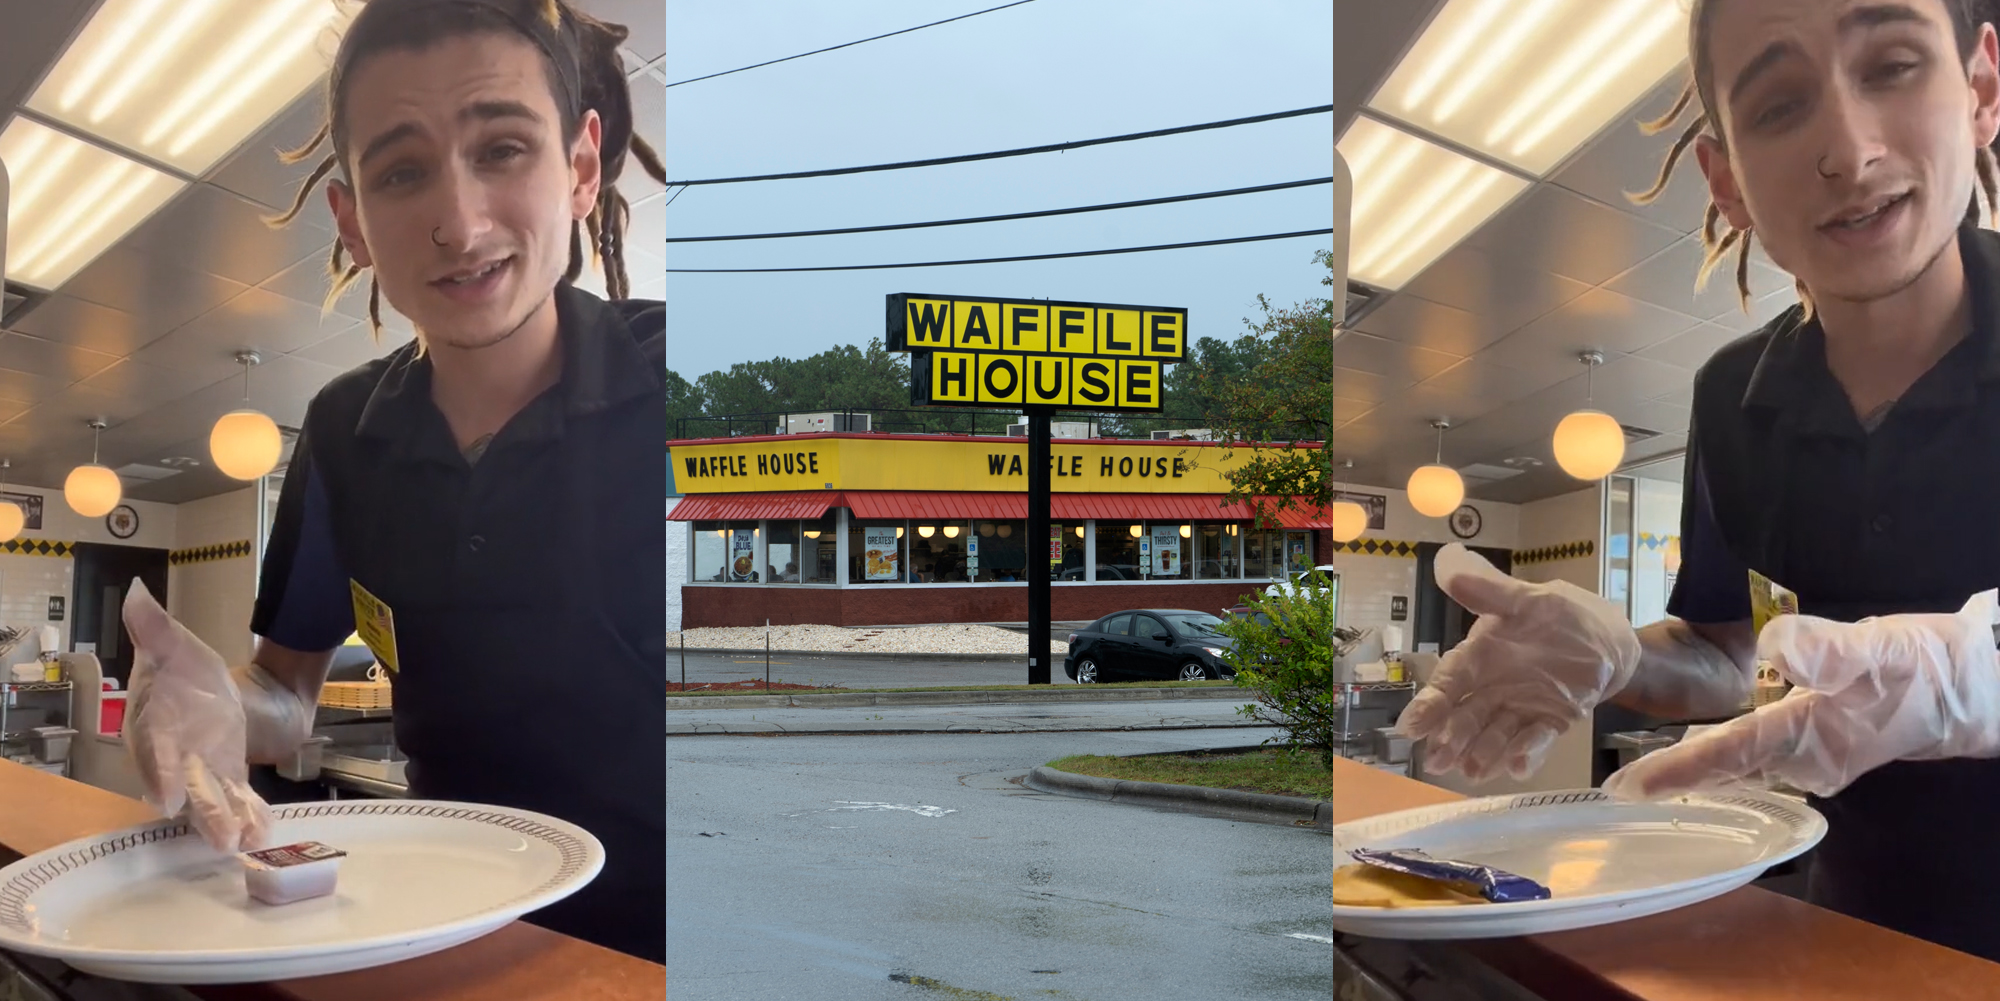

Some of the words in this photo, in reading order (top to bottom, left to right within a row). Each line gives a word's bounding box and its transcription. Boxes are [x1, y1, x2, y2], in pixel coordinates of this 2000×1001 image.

[908, 302, 1177, 354] WAFFLE
[940, 357, 1152, 403] HOUSE
[685, 455, 747, 478] WAFFLE
[757, 452, 819, 476] HOUSE
[988, 454, 1083, 476] WALE
[1100, 456, 1184, 478] HOUSE
[735, 541, 752, 551] BLUE
[867, 535, 895, 545] GREATEST
[1154, 535, 1178, 546] THIRSTY
